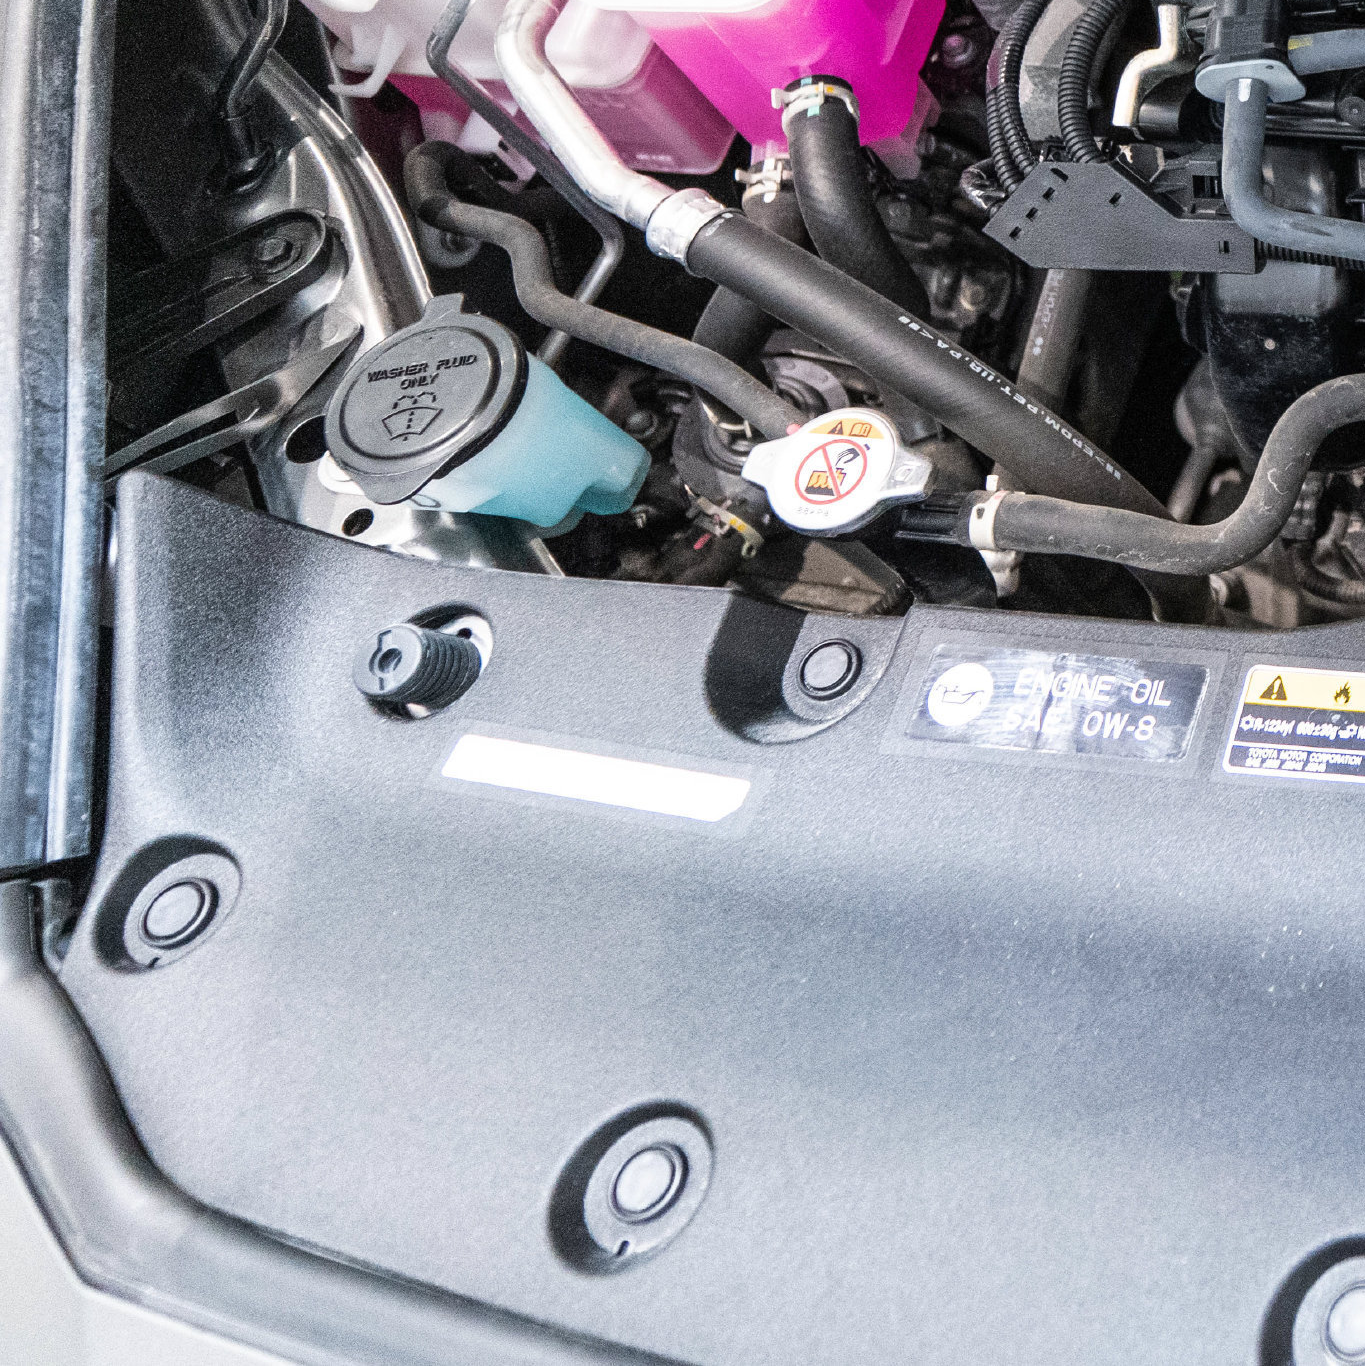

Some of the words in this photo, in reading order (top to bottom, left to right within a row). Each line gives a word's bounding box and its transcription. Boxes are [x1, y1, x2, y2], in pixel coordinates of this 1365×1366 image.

[367, 360, 429, 383] WASHER
[436, 353, 478, 371] FLUID
[399, 371, 440, 390] ONLY
[1013, 667, 1116, 702] ENGINE
[1130, 678, 1172, 708] OIL
[1003, 704, 1062, 734] SAE
[1248, 747, 1278, 759] TOYOTA
[1279, 749, 1308, 762] MOTOR
[1309, 751, 1363, 766] CORPORATION
